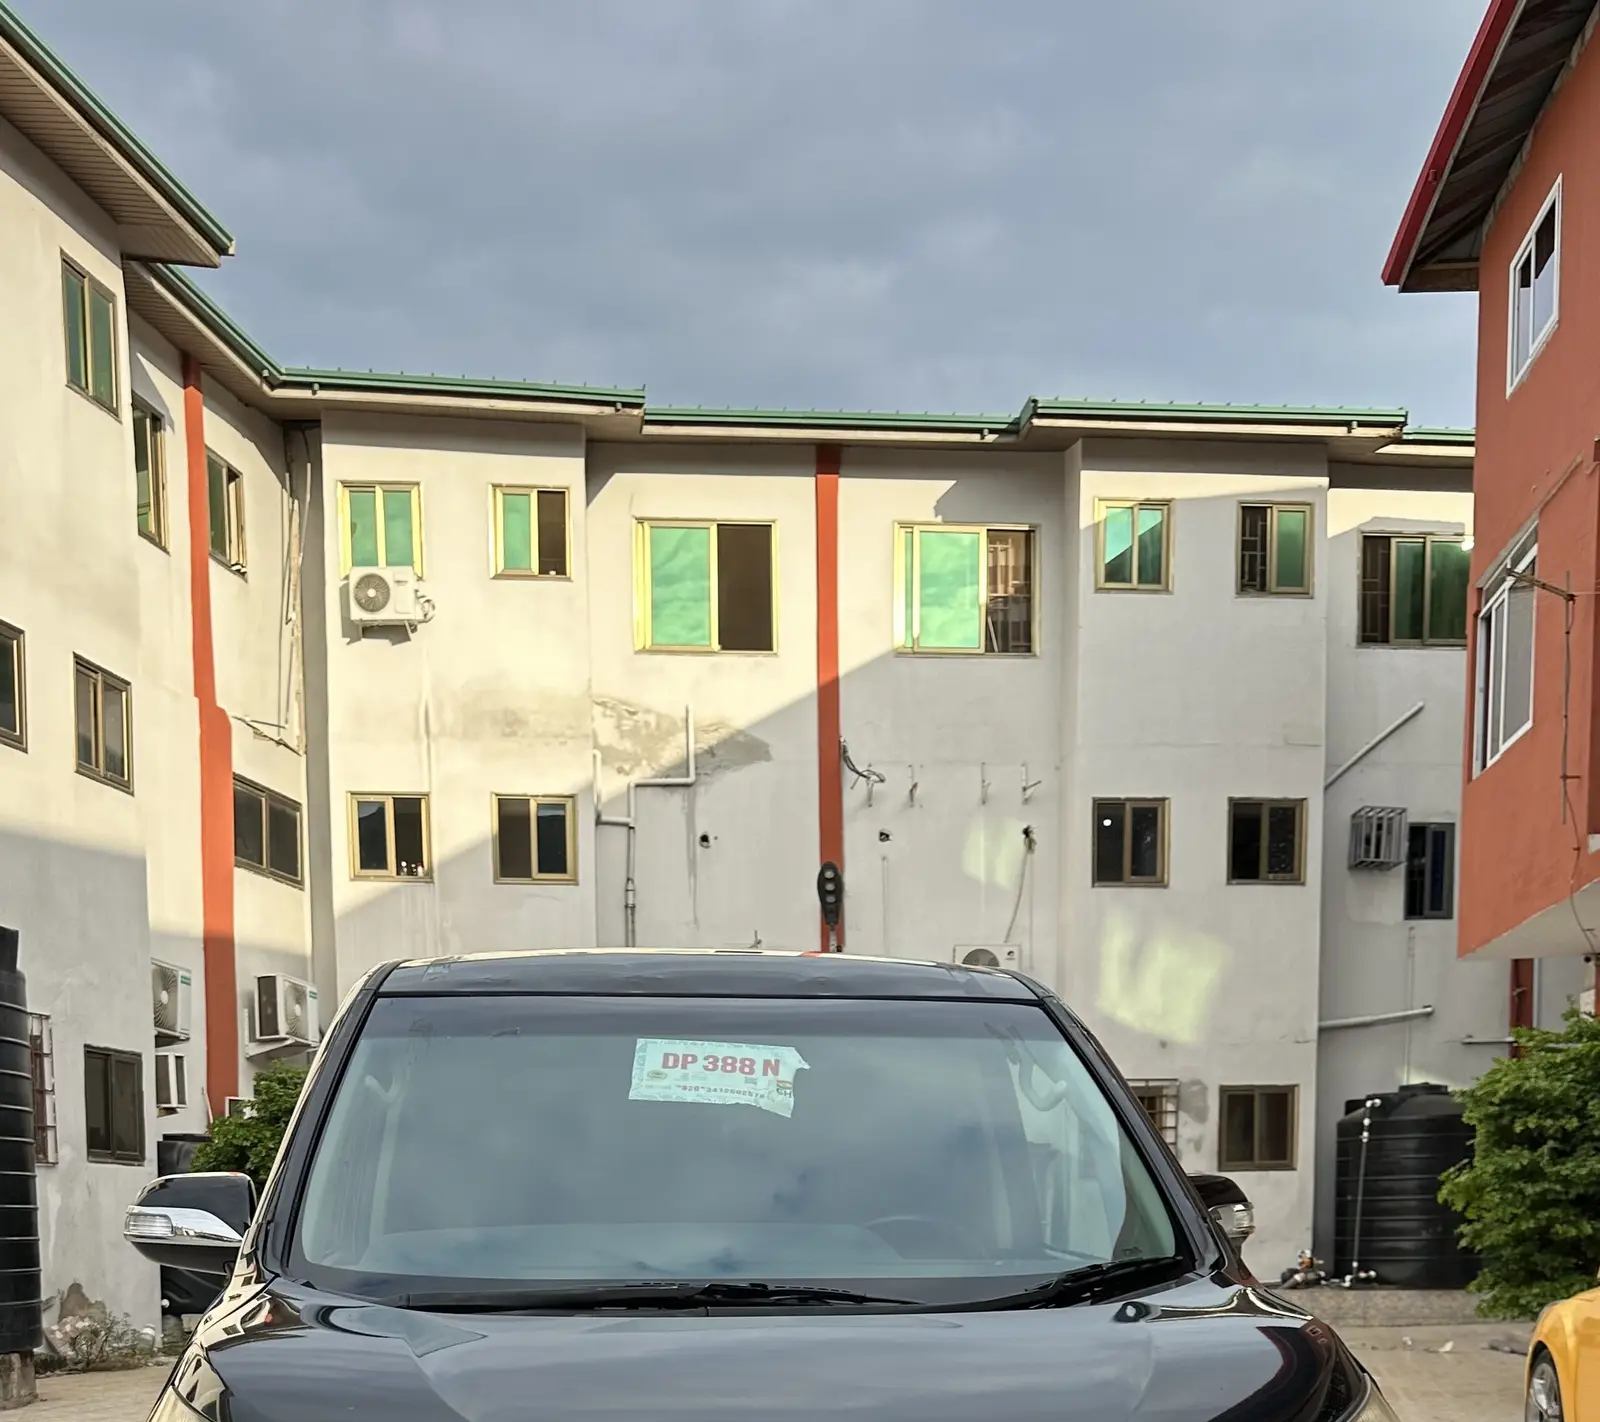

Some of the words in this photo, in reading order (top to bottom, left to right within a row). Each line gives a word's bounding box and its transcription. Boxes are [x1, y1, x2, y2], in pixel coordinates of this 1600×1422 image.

[662, 1053, 697, 1070] DP
[703, 1054, 756, 1076] 388
[763, 1058, 781, 1076] N
